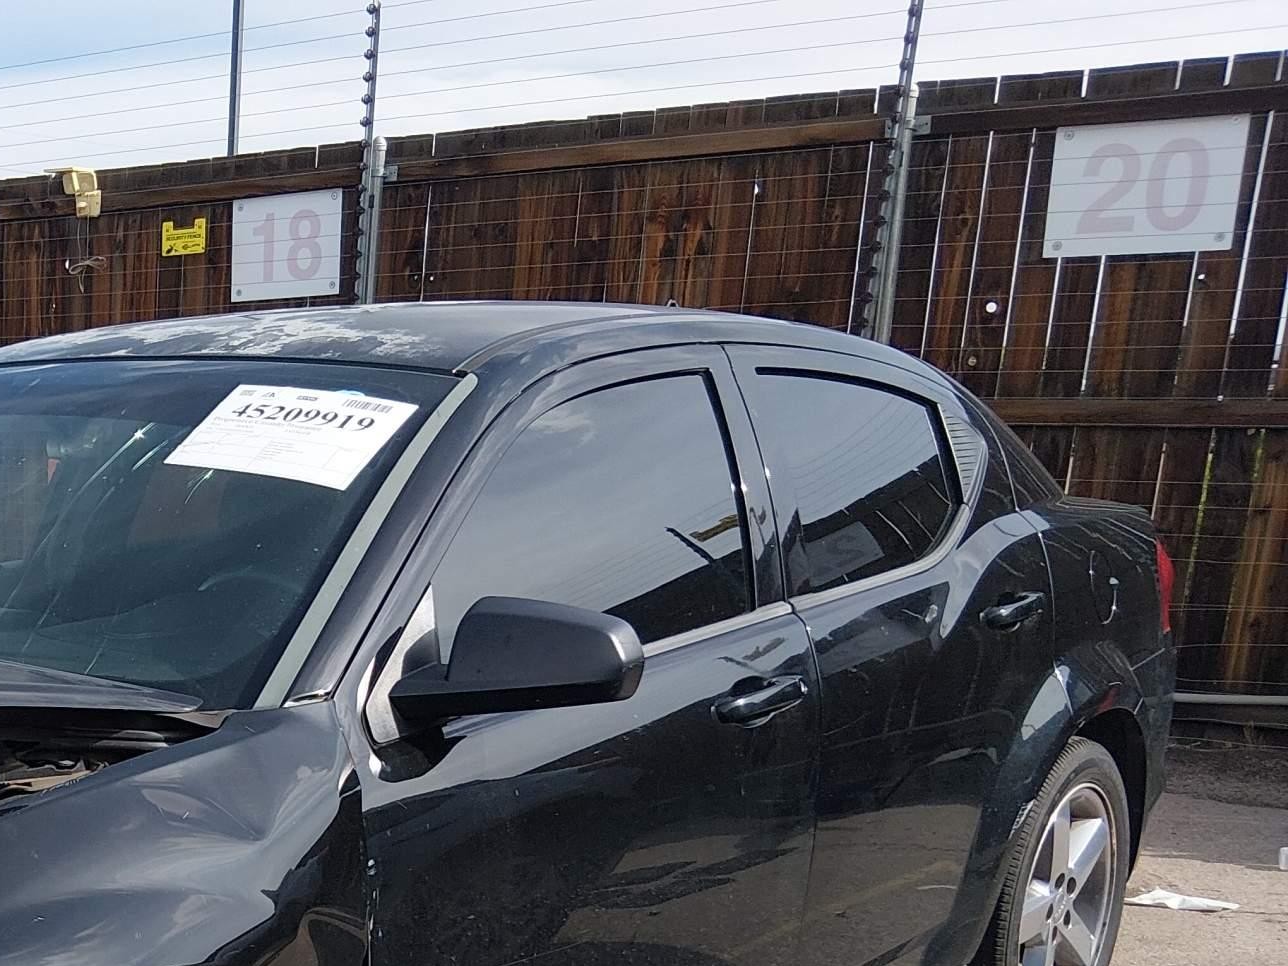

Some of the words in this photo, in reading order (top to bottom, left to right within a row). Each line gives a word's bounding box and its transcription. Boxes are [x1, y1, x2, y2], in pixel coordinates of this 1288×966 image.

[1075, 137, 1211, 235] 20
[252, 209, 323, 283] 18
[232, 402, 376, 432] 45209919
